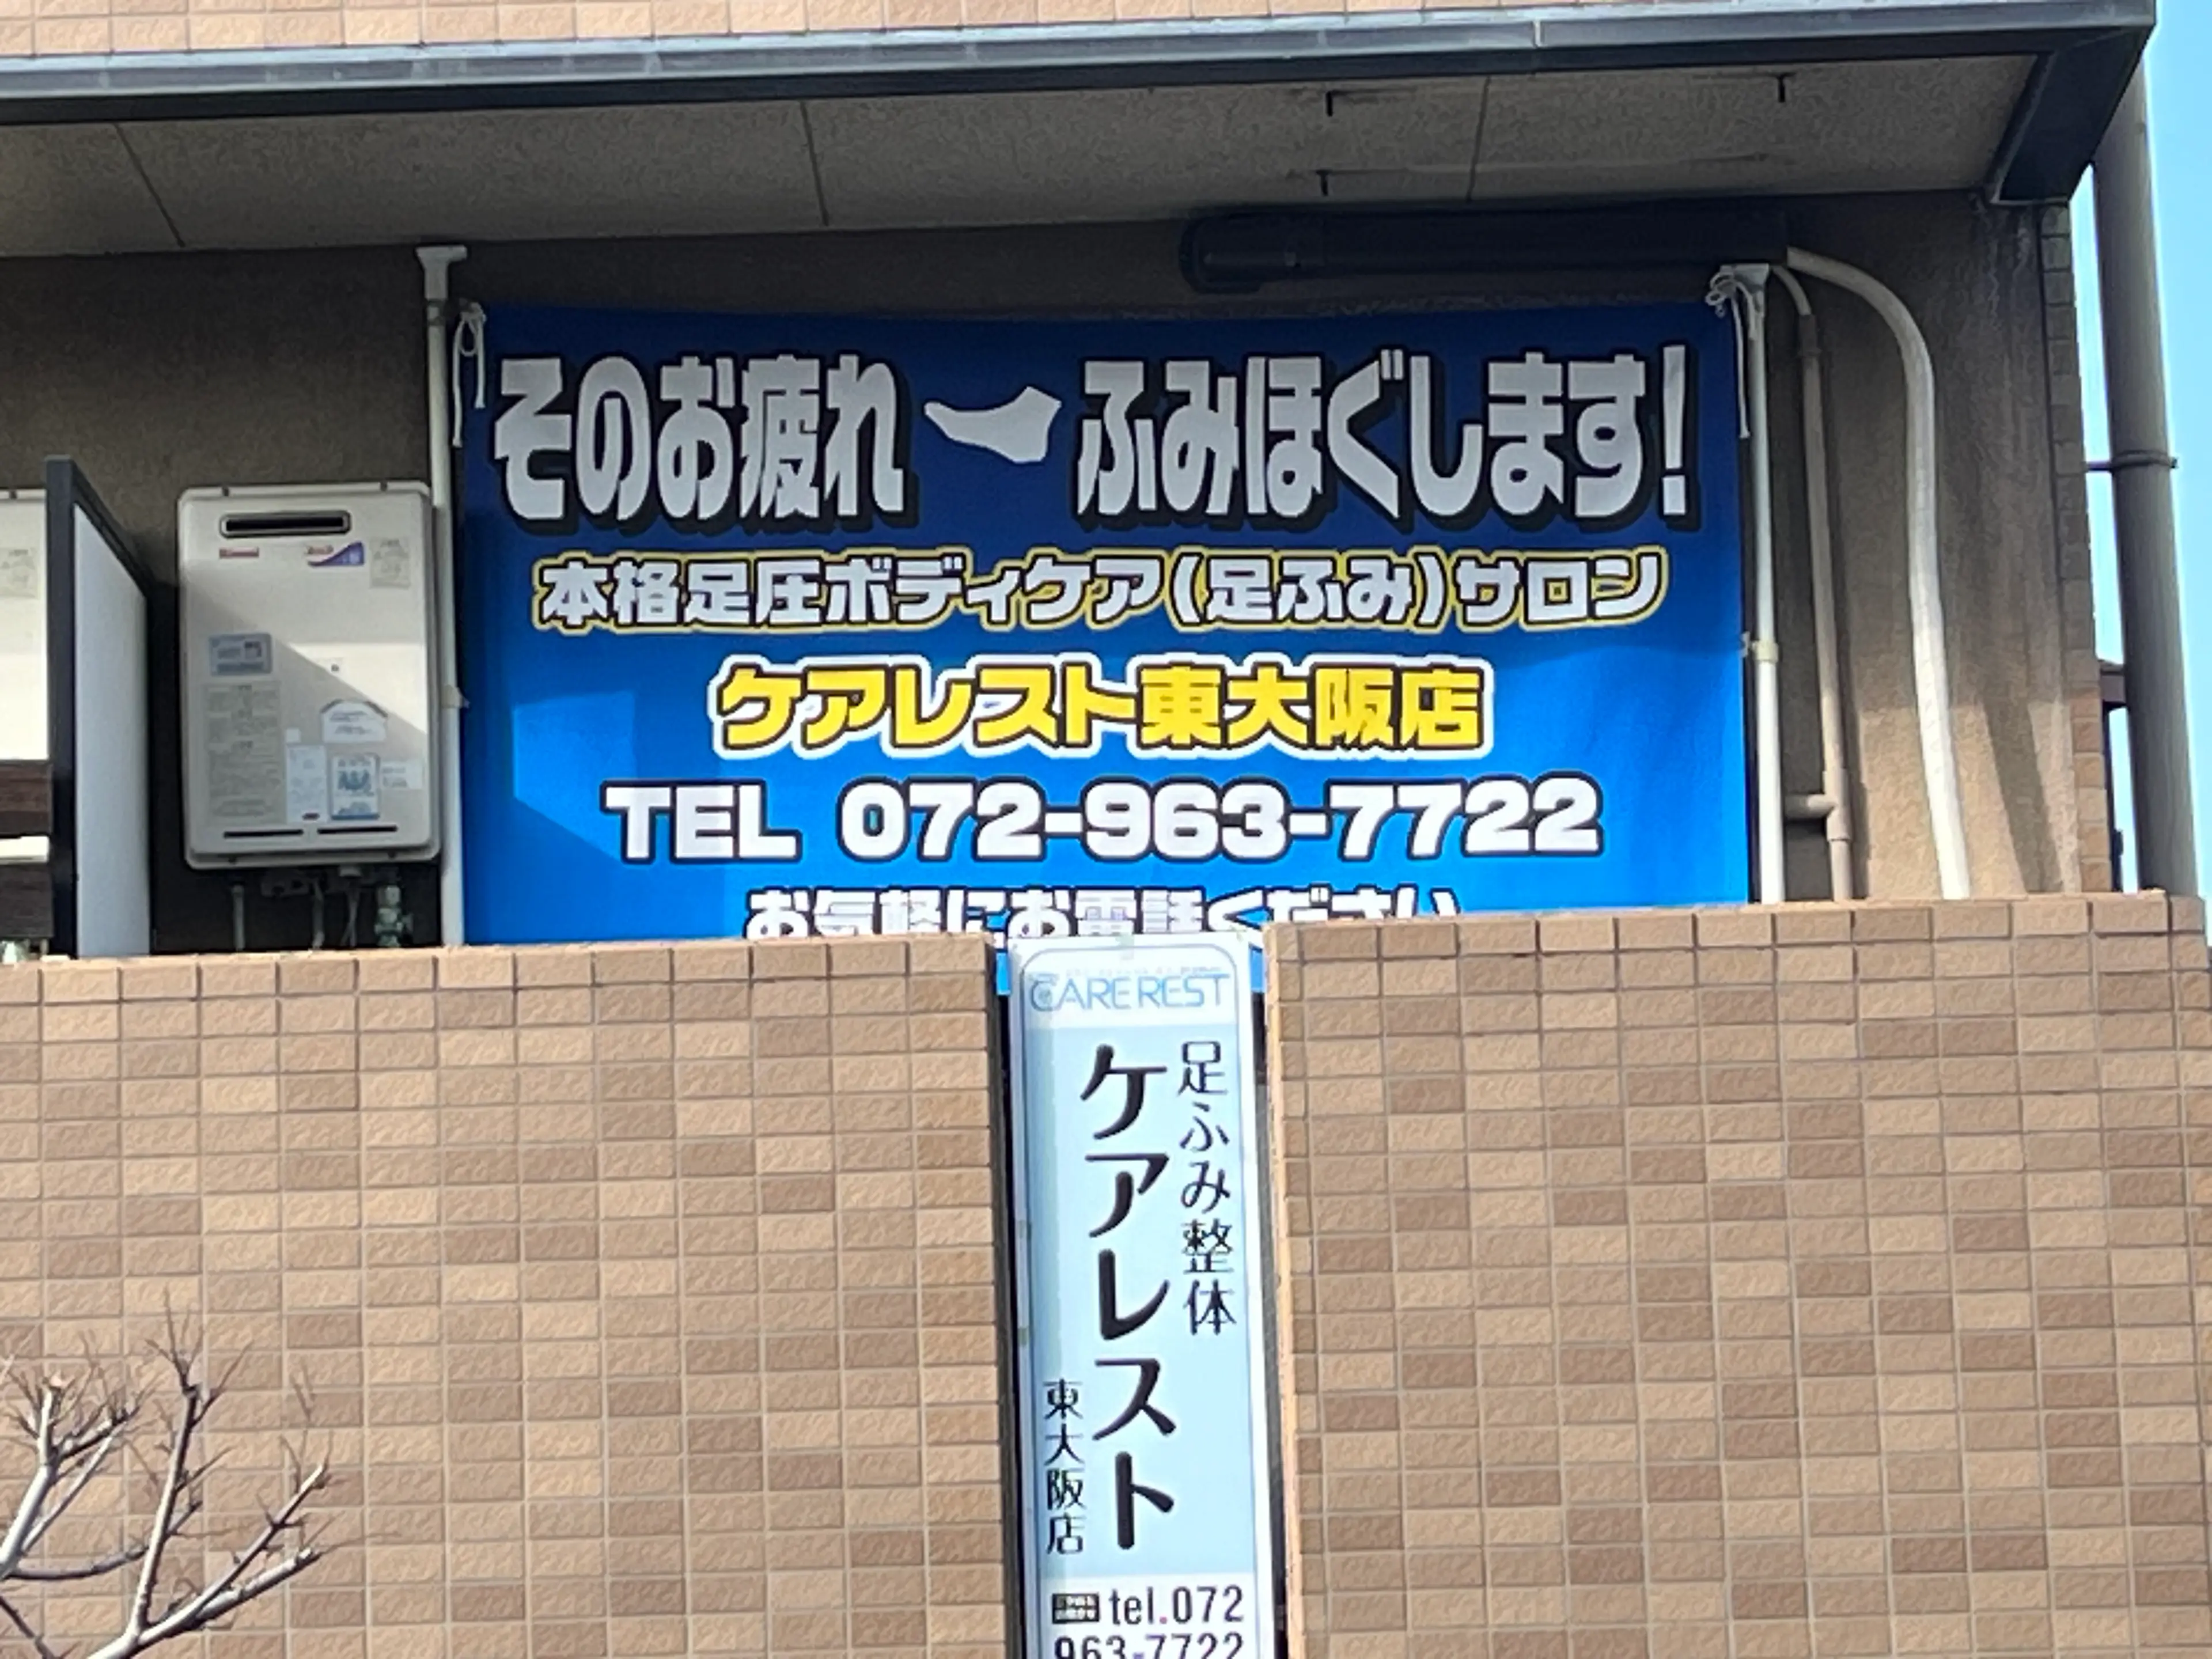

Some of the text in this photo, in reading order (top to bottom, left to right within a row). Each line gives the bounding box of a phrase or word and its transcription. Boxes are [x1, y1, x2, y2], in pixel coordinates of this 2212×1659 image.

[493, 344, 1688, 521] そのお疲れ ふみほぐします!
[719, 662, 1483, 750] ケアレスト東大阪店
[603, 775, 1603, 861] TEL 072-963-7722
[1177, 1039, 1237, 1336] 足ふみ整体
[1079, 1043, 1177, 1551] ケアレスト
[1041, 1378, 1086, 1555] 東大阪店
[1054, 1631, 1244, 1659] 963-7722
